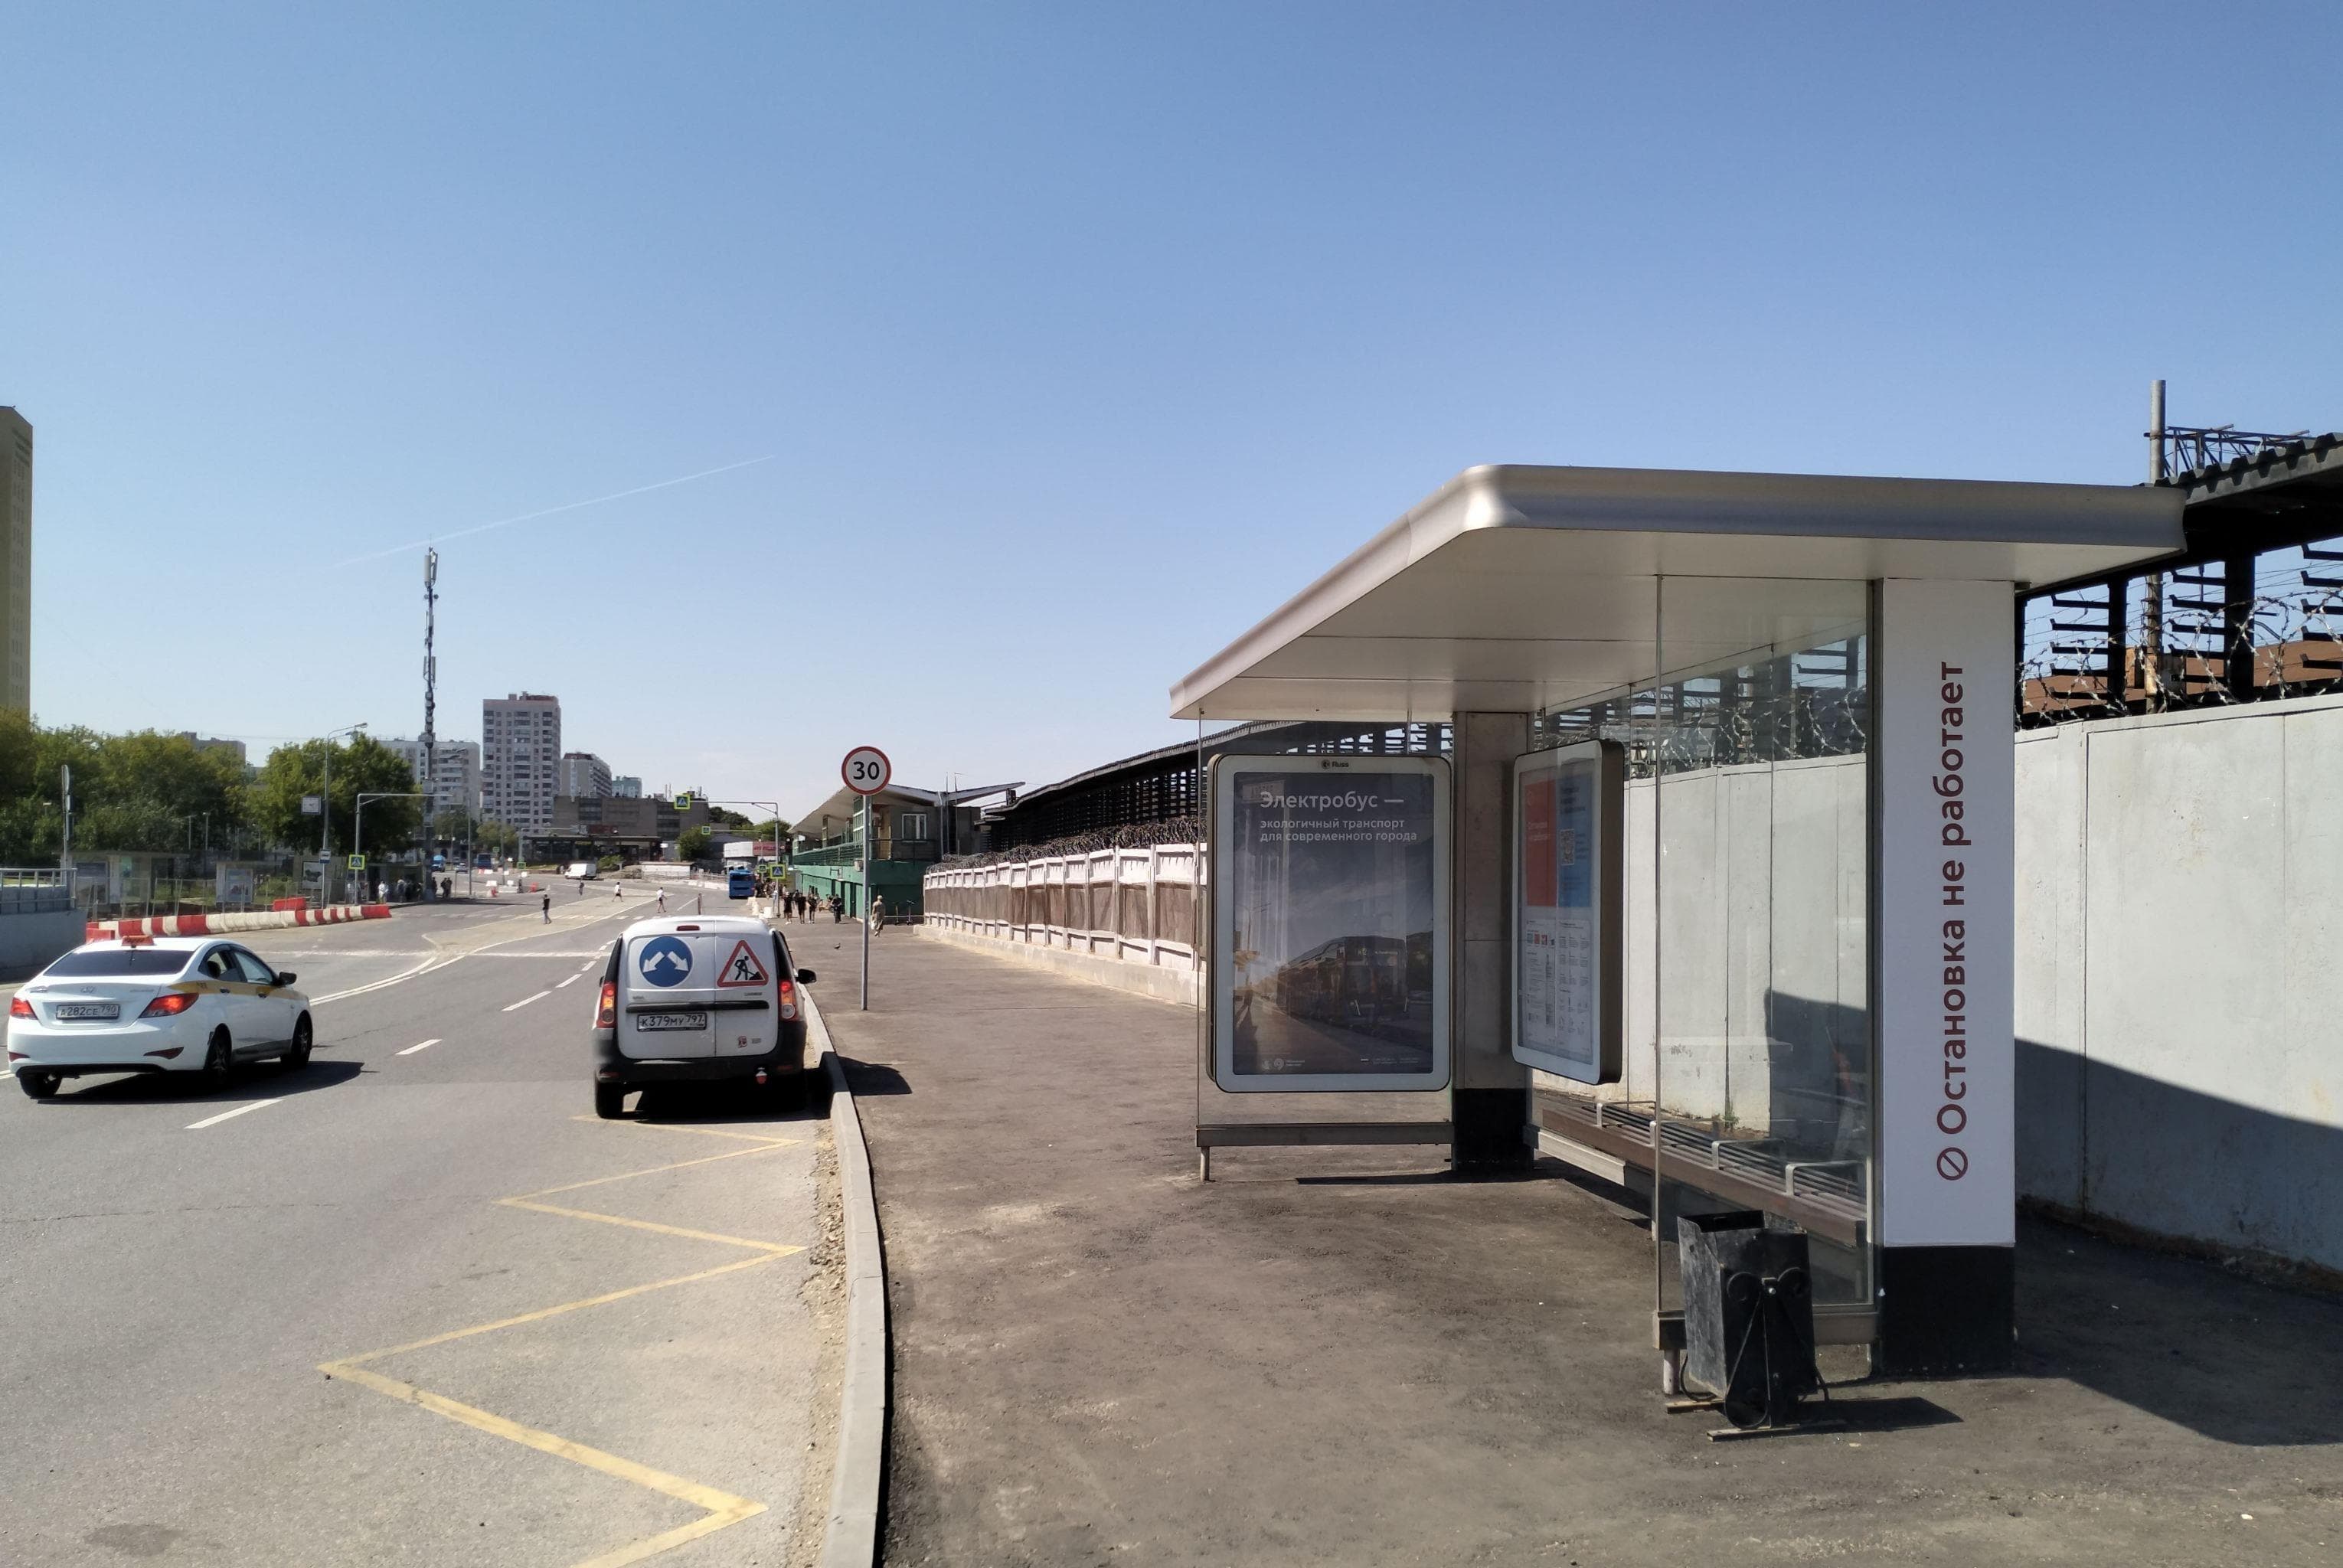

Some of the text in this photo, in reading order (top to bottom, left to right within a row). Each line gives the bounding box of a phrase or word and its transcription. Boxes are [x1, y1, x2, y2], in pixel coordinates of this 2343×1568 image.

[853, 761, 880, 780] 30
[1260, 791, 1378, 812] Электробус
[1260, 818, 1405, 830] экологичный транспорт
[1260, 832, 1417, 843] для современного города
[1933, 662, 1972, 1135] Остановка не работает
